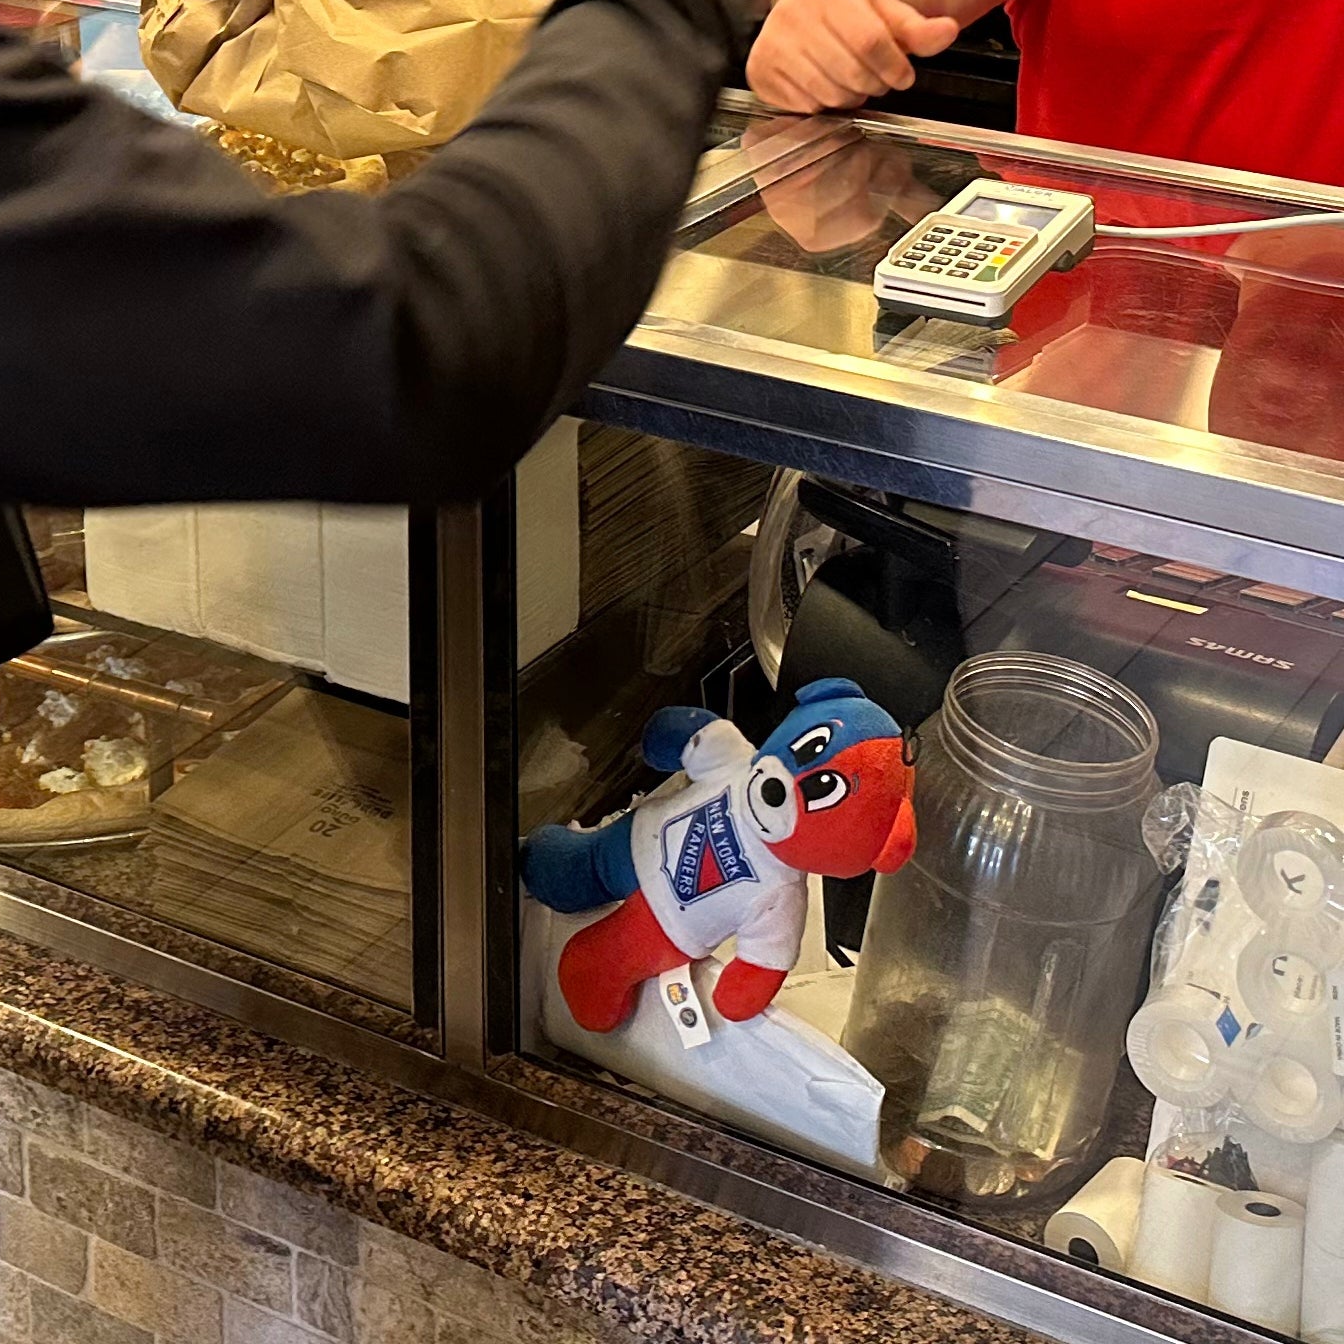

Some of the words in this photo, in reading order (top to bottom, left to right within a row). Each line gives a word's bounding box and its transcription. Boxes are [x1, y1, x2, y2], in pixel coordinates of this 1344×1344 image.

[310, 820, 342, 837] 20
[709, 802, 726, 833] NEW
[678, 822, 706, 895] RANGERS
[716, 838, 742, 879] YORK
